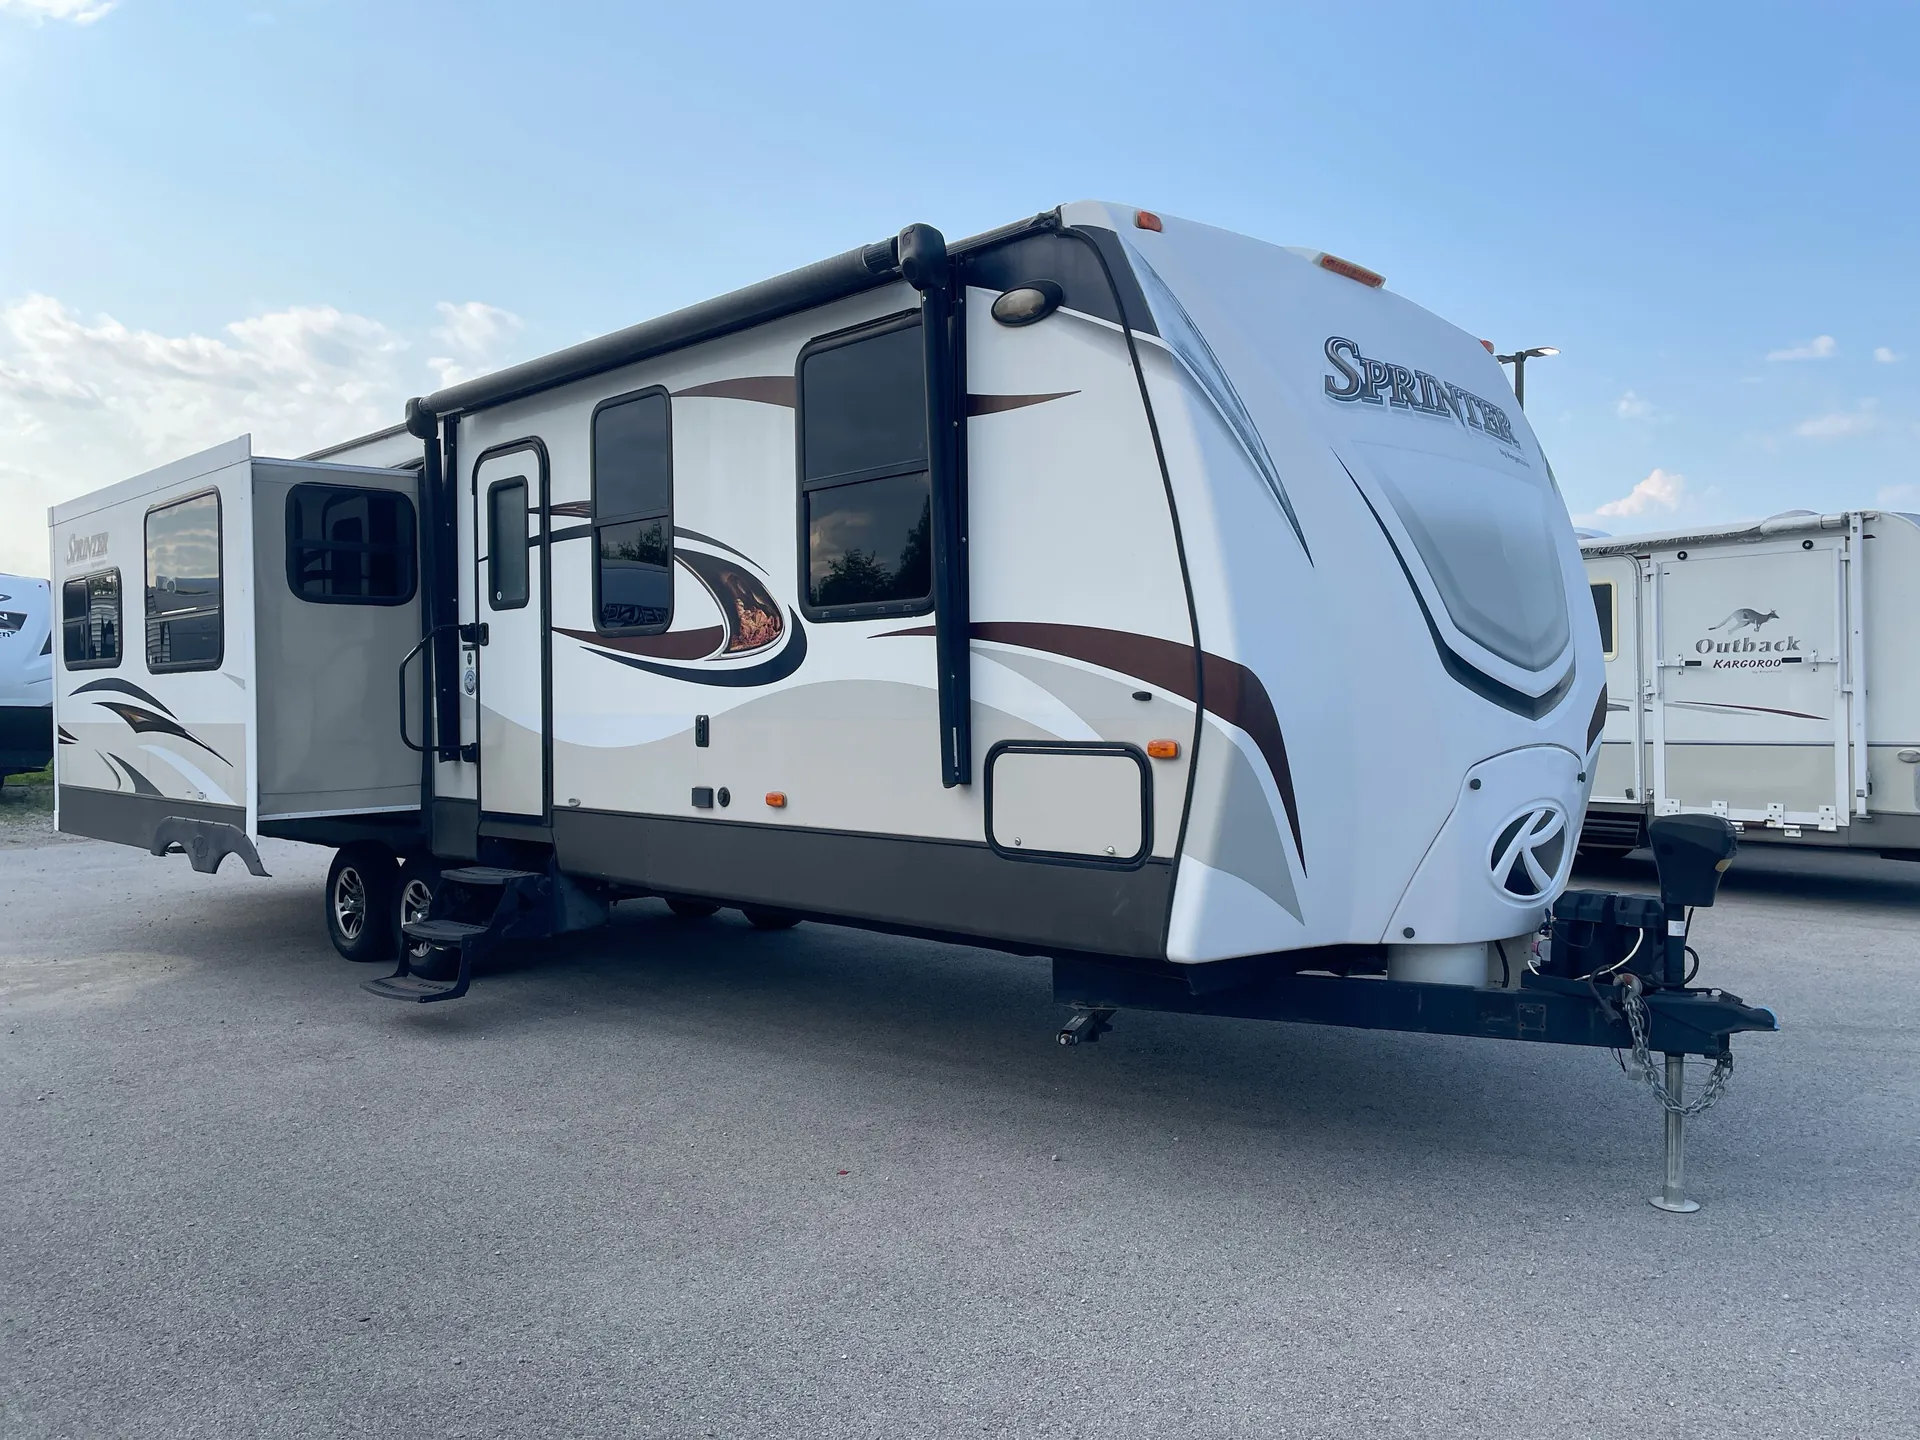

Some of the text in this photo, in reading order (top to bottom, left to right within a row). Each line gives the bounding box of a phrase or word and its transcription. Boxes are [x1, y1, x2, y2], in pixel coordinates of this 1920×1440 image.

[1324, 336, 1522, 450] SPRINTER
[1695, 636, 1801, 654] Outback
[1713, 658, 1782, 669] KARGOROO
